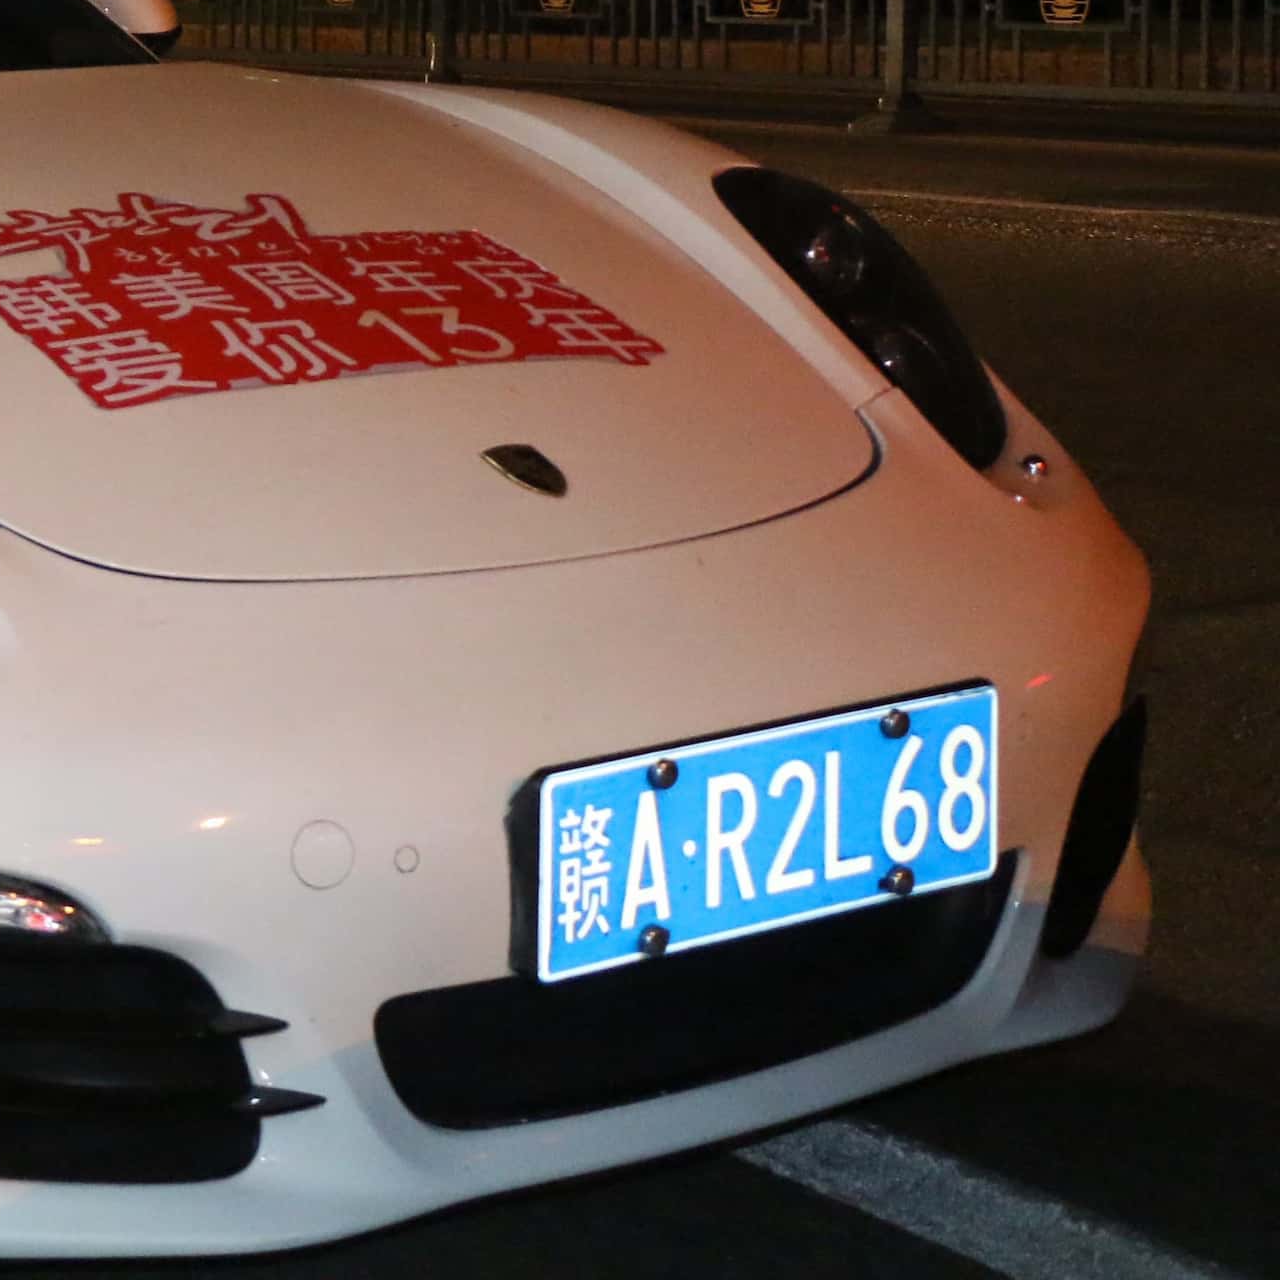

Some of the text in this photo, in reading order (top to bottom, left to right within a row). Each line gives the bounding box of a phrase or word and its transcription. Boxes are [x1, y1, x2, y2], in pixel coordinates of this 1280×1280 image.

[47, 303, 652, 403] 爱你13年
[557, 723, 987, 944] 赣A·R2L68
